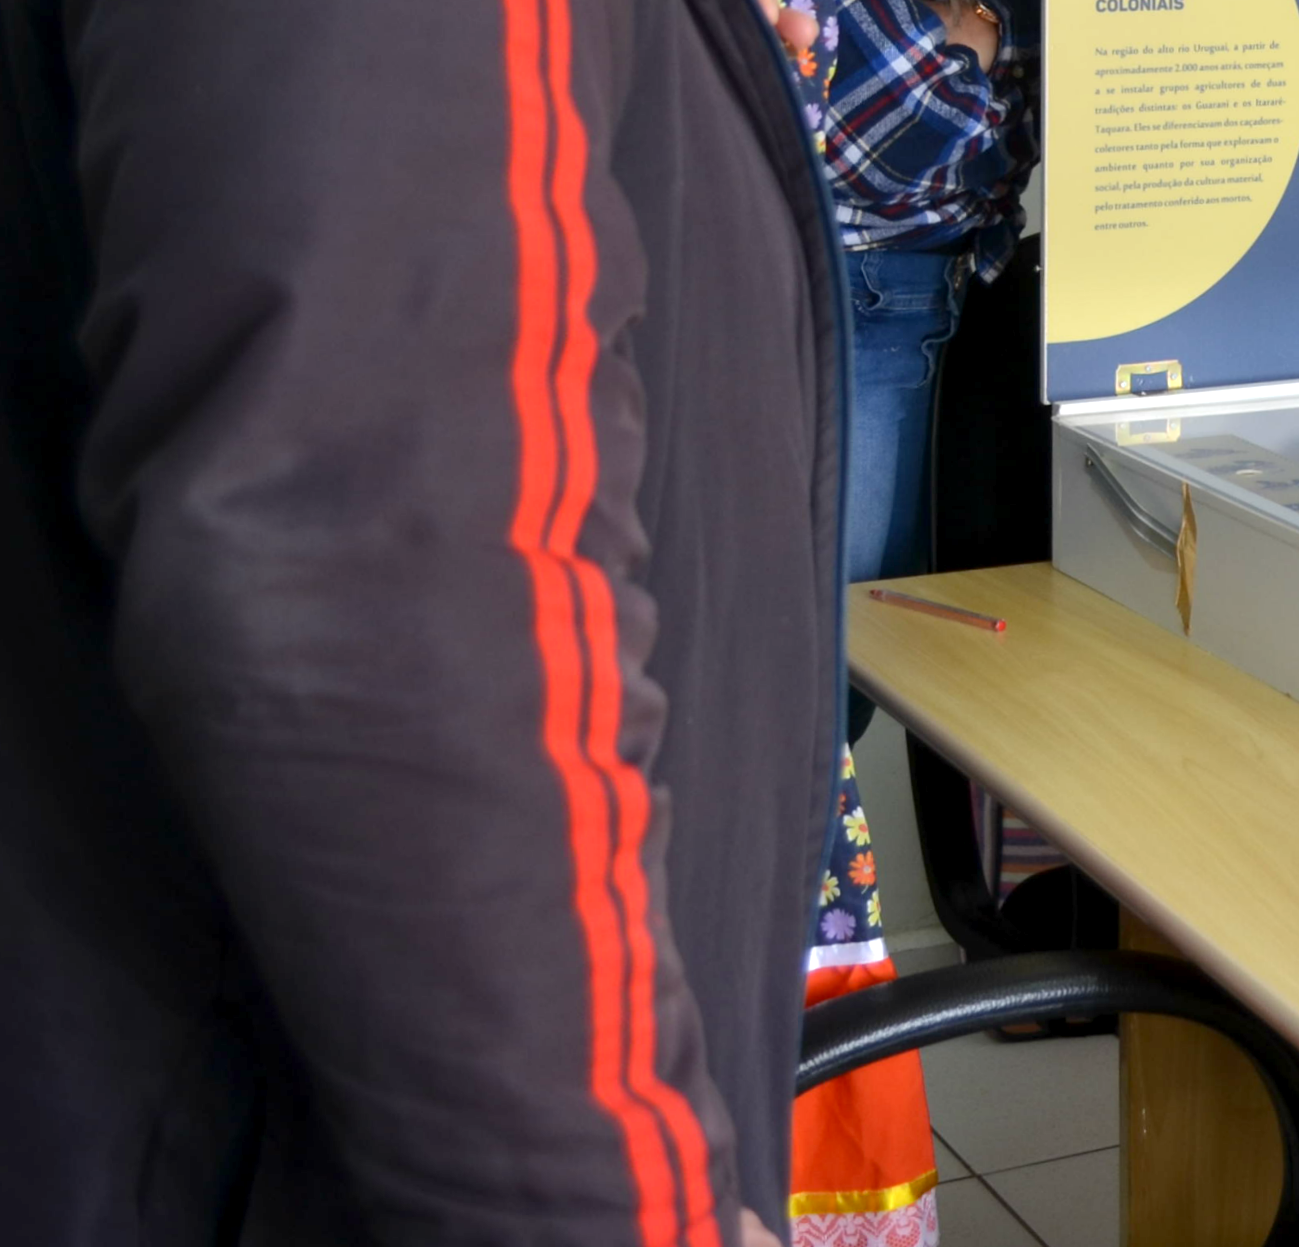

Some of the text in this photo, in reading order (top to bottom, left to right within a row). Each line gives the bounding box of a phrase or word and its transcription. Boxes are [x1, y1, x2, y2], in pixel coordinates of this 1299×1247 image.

[1094, 47, 1107, 56] Na
[1111, 45, 1139, 58] região
[1142, 44, 1153, 54] do
[1157, 43, 1174, 54] alto
[1177, 44, 1190, 53] rio
[1193, 42, 1229, 55] Uruguai,
[1242, 41, 1265, 53] partir
[1269, 39, 1279, 49] de
[1094, 63, 1173, 78] aproximadamente
[1174, 62, 1198, 72] 2.000
[1219, 61, 1242, 71] atrás,
[1244, 61, 1284, 71] começam
